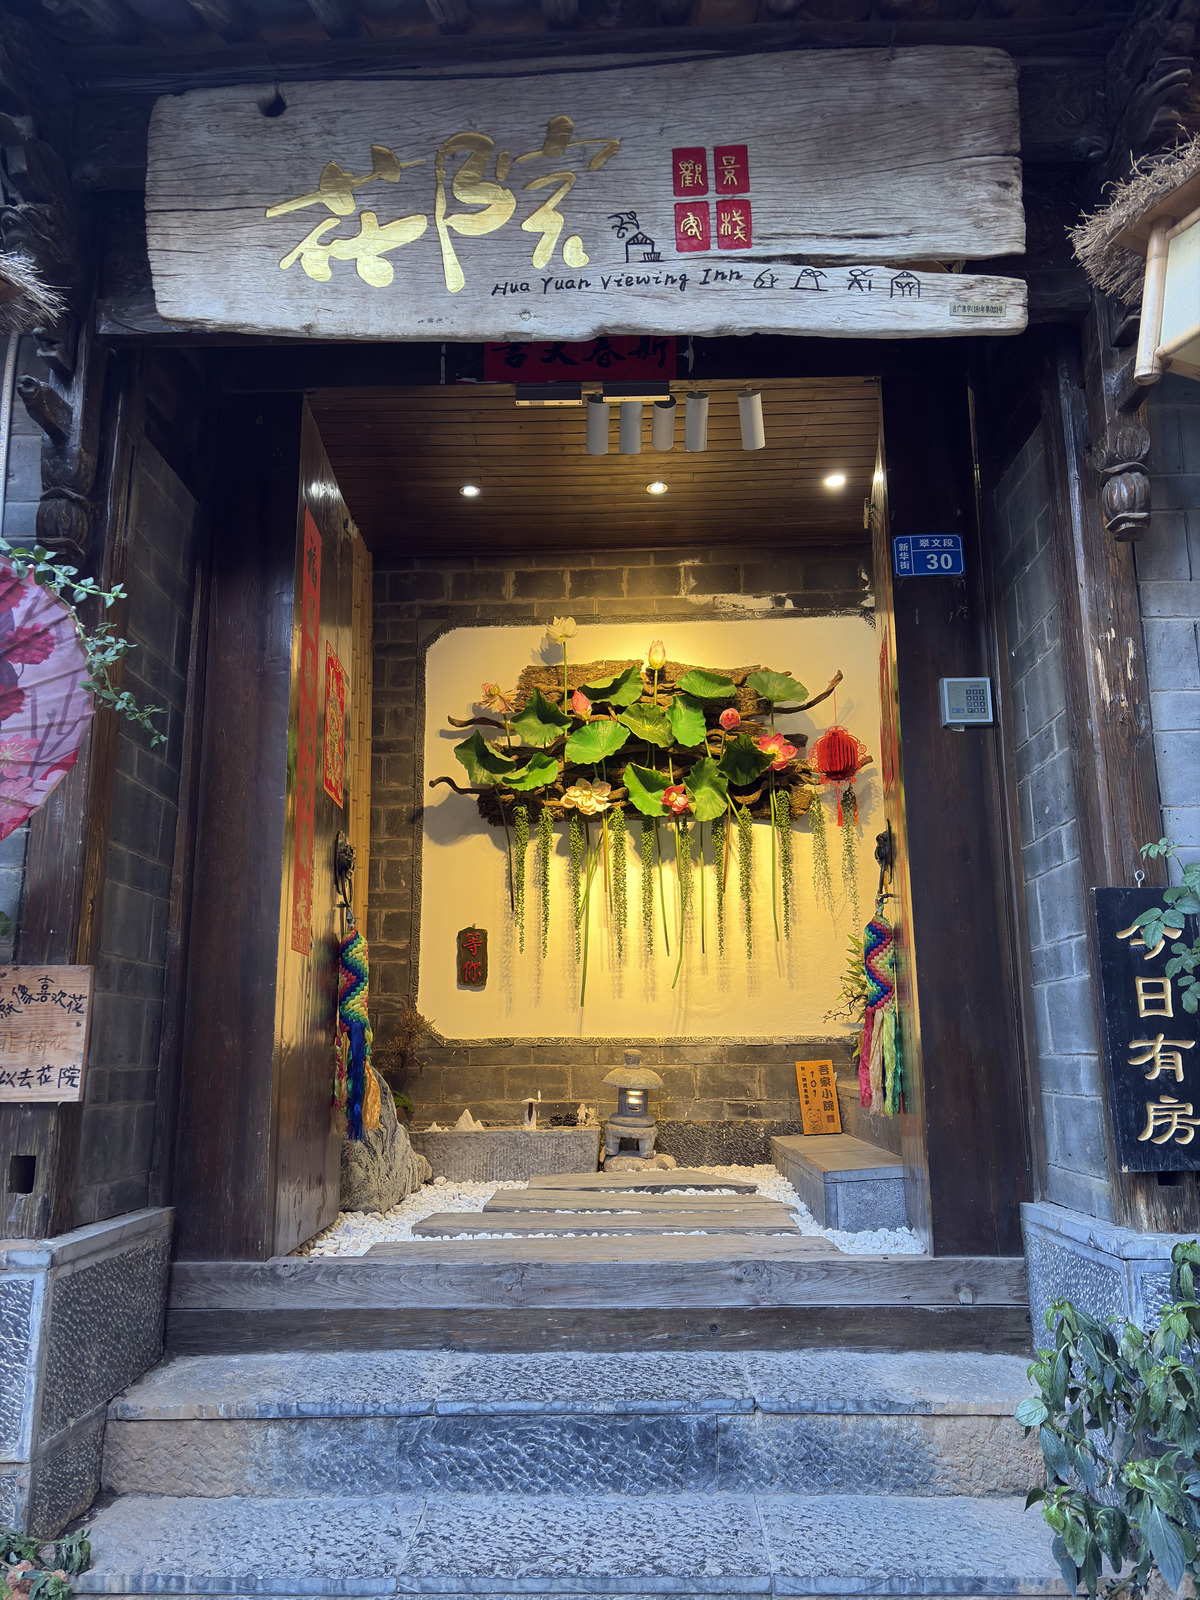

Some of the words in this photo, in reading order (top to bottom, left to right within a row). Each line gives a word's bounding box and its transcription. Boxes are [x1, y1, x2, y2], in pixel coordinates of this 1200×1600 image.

[265, 113, 621, 293] 花院
[491, 280, 530, 296] Hua
[540, 276, 592, 295] Yuan
[600, 271, 690, 292] Viewing
[699, 268, 744, 285] Inn
[898, 542, 910, 570] 新华街
[918, 538, 954, 548] 翠文段
[926, 553, 952, 570] 30
[462, 932, 483, 983] 等你
[1115, 922, 1200, 1146] 今日有房
